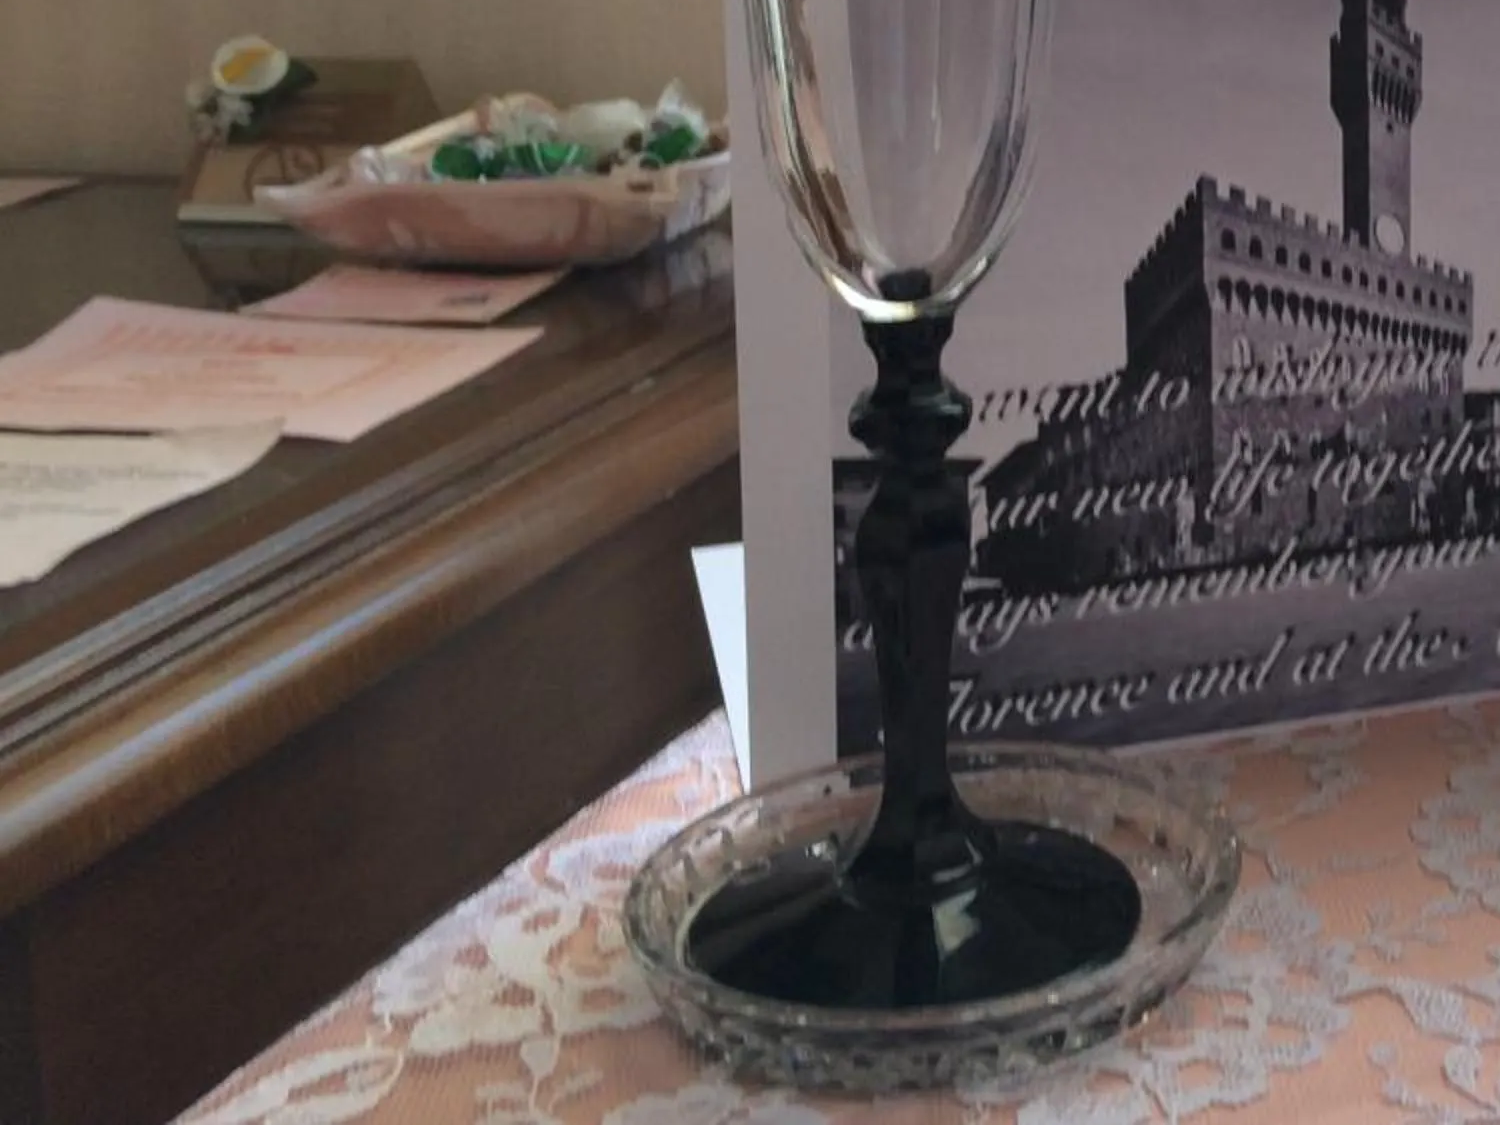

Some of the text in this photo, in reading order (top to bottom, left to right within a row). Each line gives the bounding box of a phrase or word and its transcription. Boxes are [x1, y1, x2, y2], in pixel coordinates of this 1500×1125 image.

[978, 376, 1119, 423] want
[1137, 371, 1190, 415] to
[1332, 347, 1462, 411] you
[1074, 477, 1190, 521] new
[1204, 427, 1294, 525] life
[843, 587, 1060, 654] aays
[1077, 536, 1352, 619] remember
[1347, 536, 1500, 599] your
[944, 678, 1147, 732] lorence
[1168, 627, 1294, 704] and
[1295, 635, 1355, 685] at
[1364, 611, 1447, 674] the
